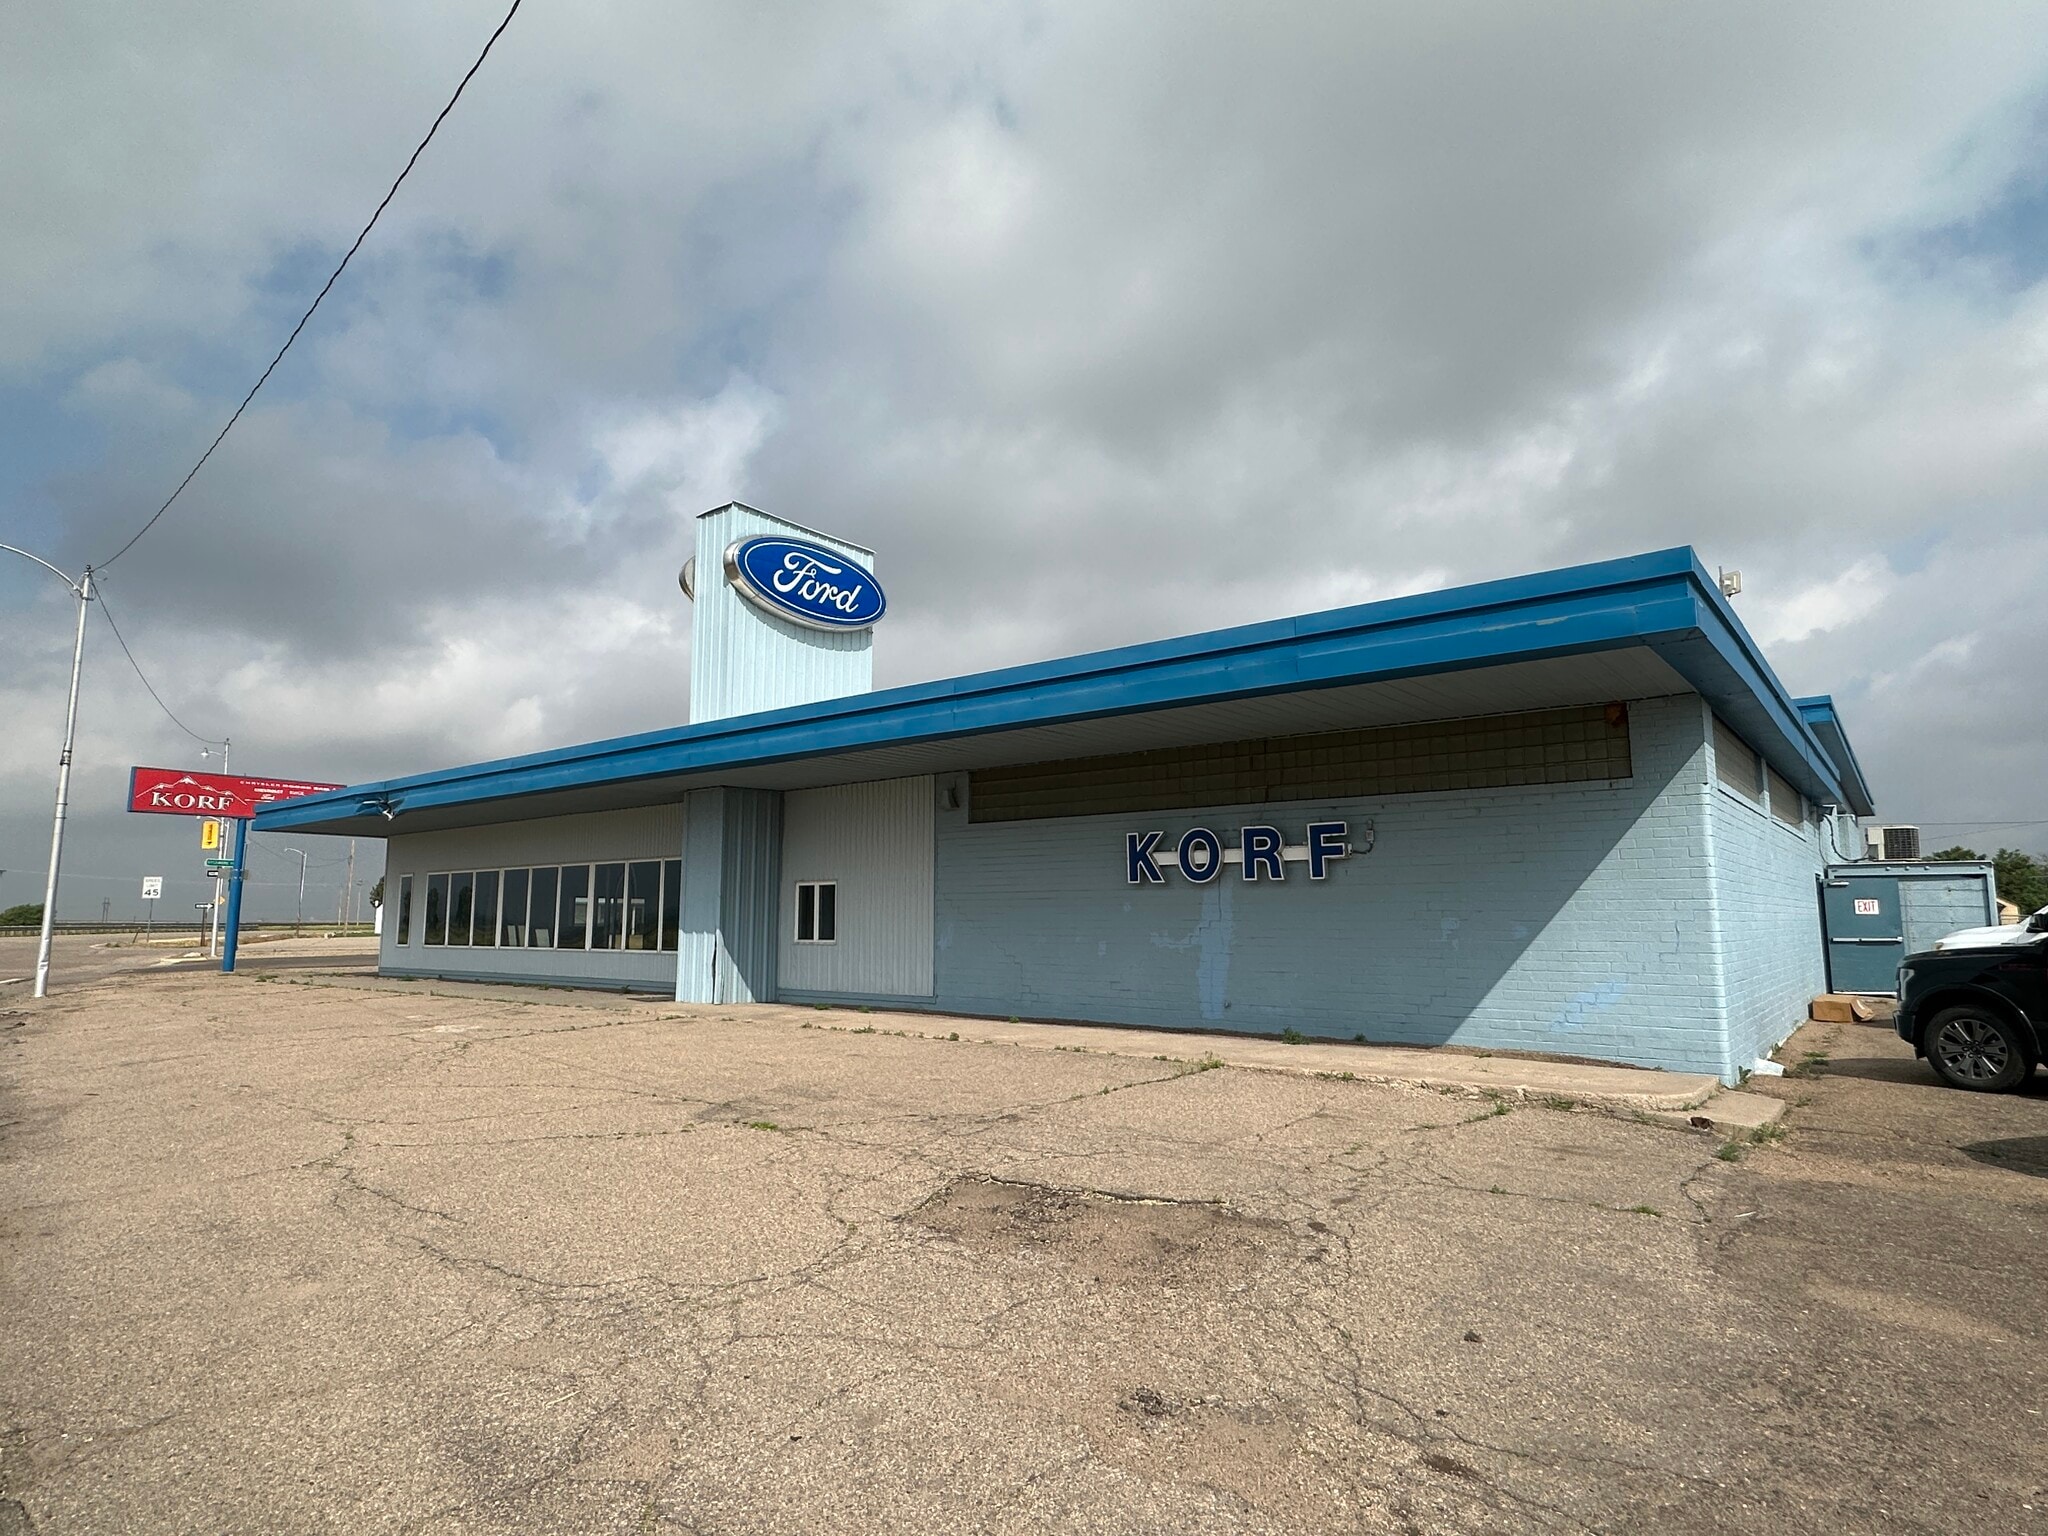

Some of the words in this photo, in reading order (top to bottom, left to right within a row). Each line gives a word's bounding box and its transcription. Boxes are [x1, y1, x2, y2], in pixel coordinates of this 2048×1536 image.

[773, 552, 862, 613] Ford
[150, 791, 234, 811] KORF
[1126, 821, 1348, 885] KORF
[144, 888, 159, 896] 45
[1857, 901, 1876, 912] EXIT
